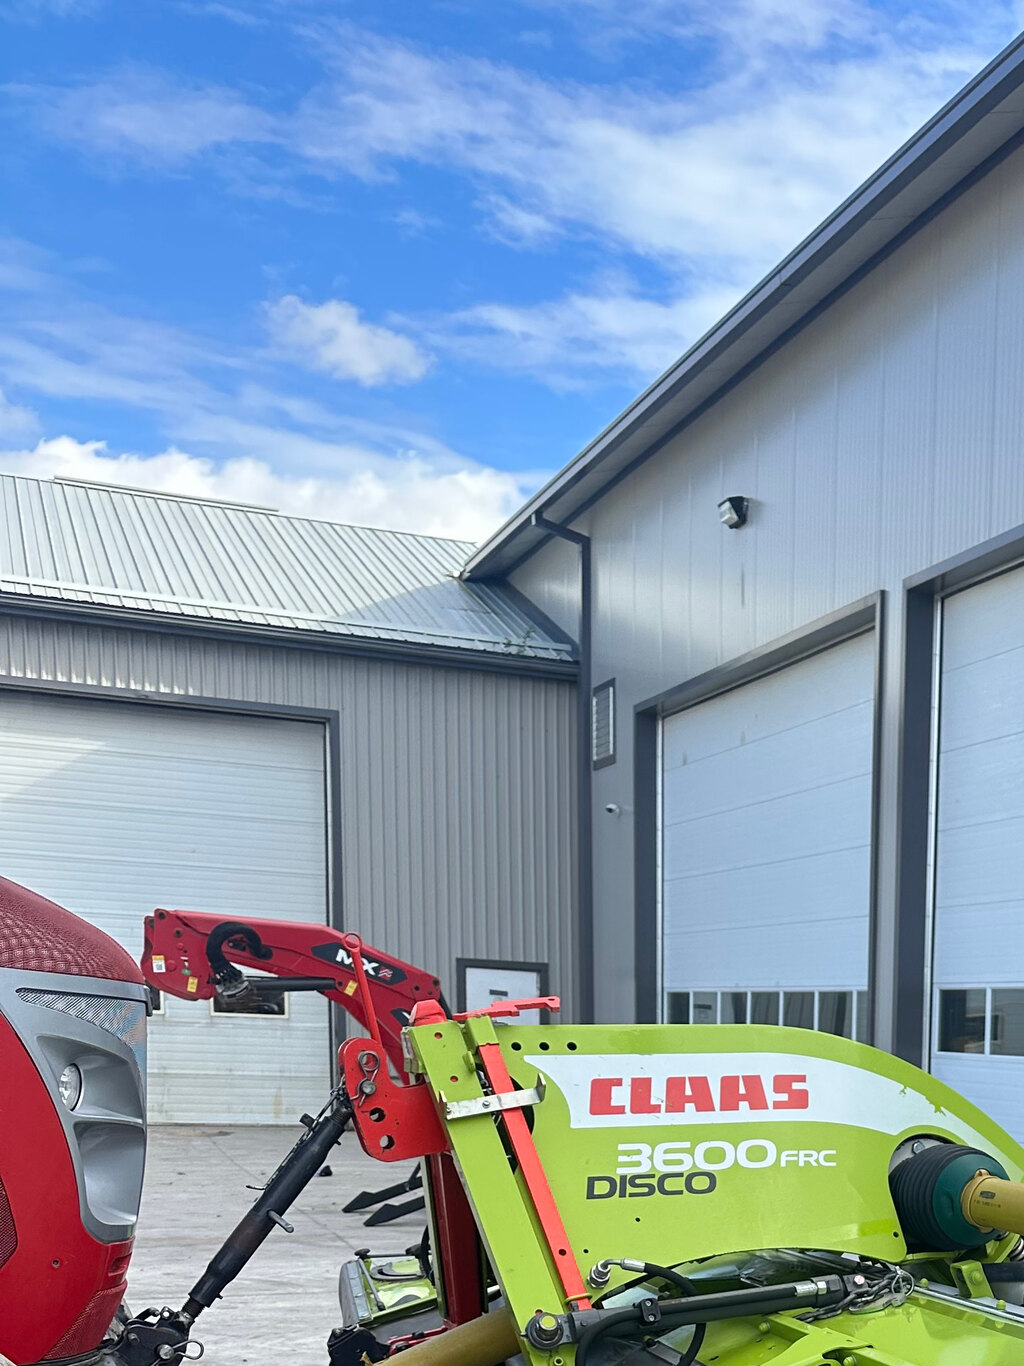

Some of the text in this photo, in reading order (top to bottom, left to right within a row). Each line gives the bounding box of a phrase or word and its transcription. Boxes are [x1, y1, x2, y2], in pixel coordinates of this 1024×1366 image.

[589, 1074, 809, 1116] CLAAS
[616, 1138, 837, 1175] 3600 FRC
[586, 1171, 717, 1200] DISCO
